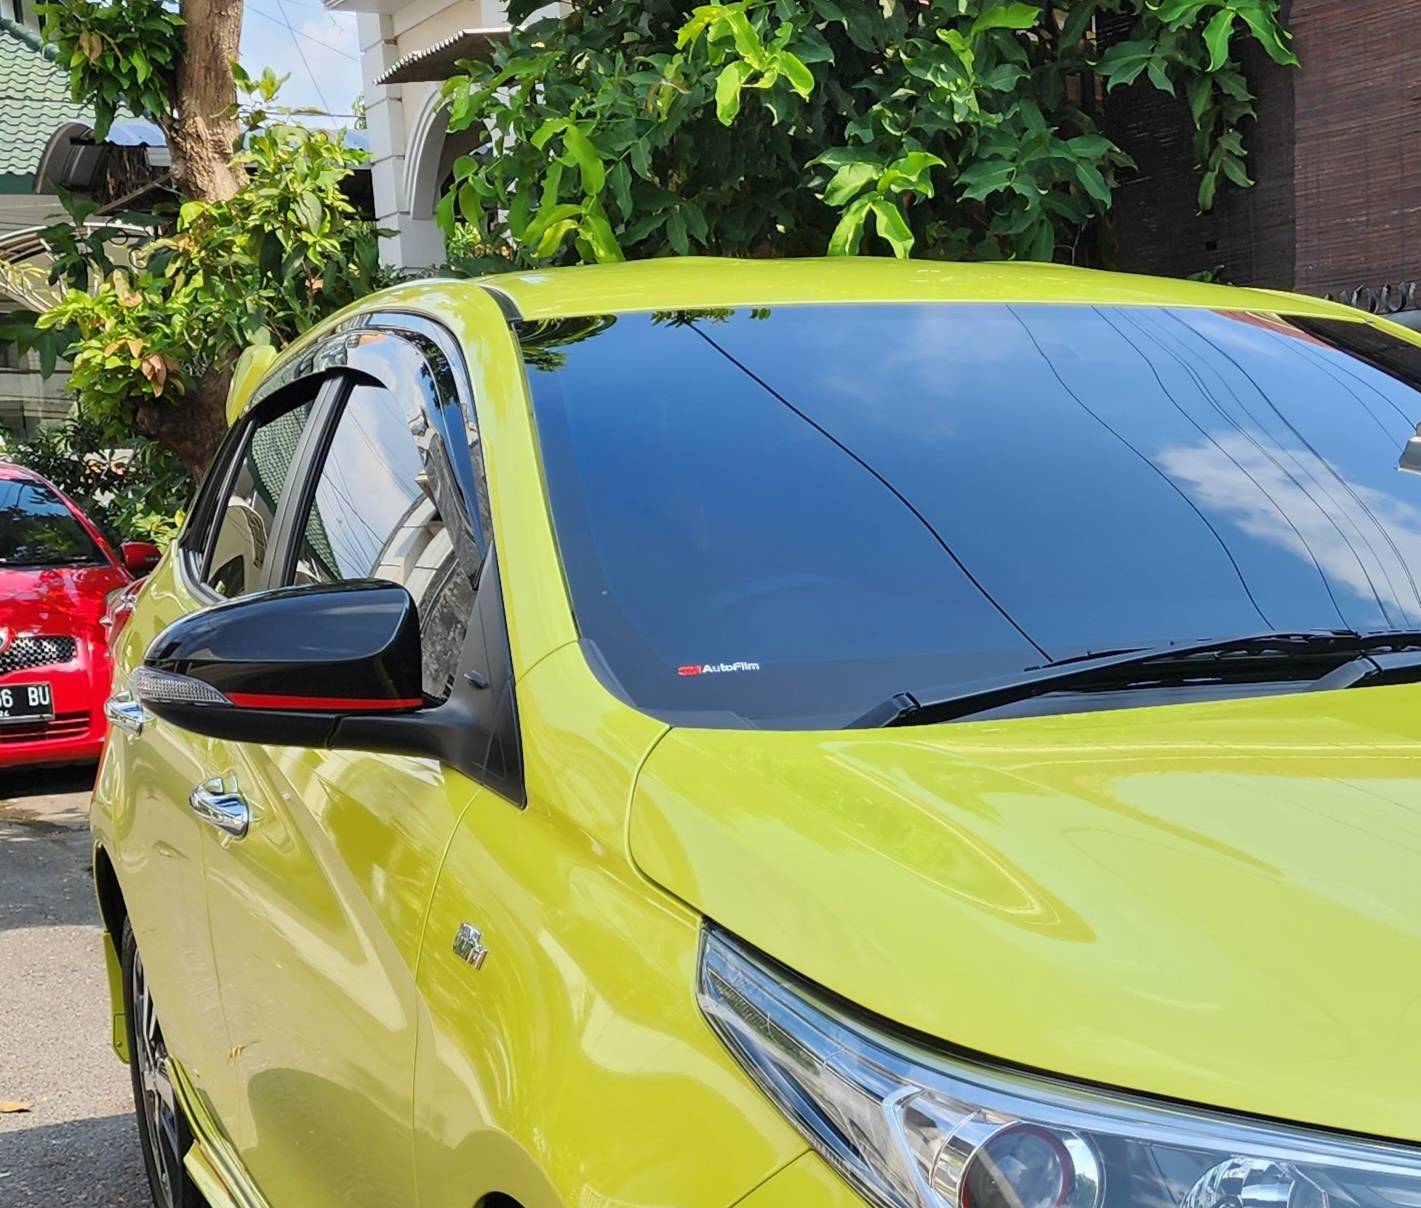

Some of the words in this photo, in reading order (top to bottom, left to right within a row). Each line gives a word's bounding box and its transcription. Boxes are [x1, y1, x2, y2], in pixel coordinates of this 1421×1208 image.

[702, 662, 760, 673] AutoFilm
[0, 689, 14, 708] 6
[27, 686, 50, 706] BU
